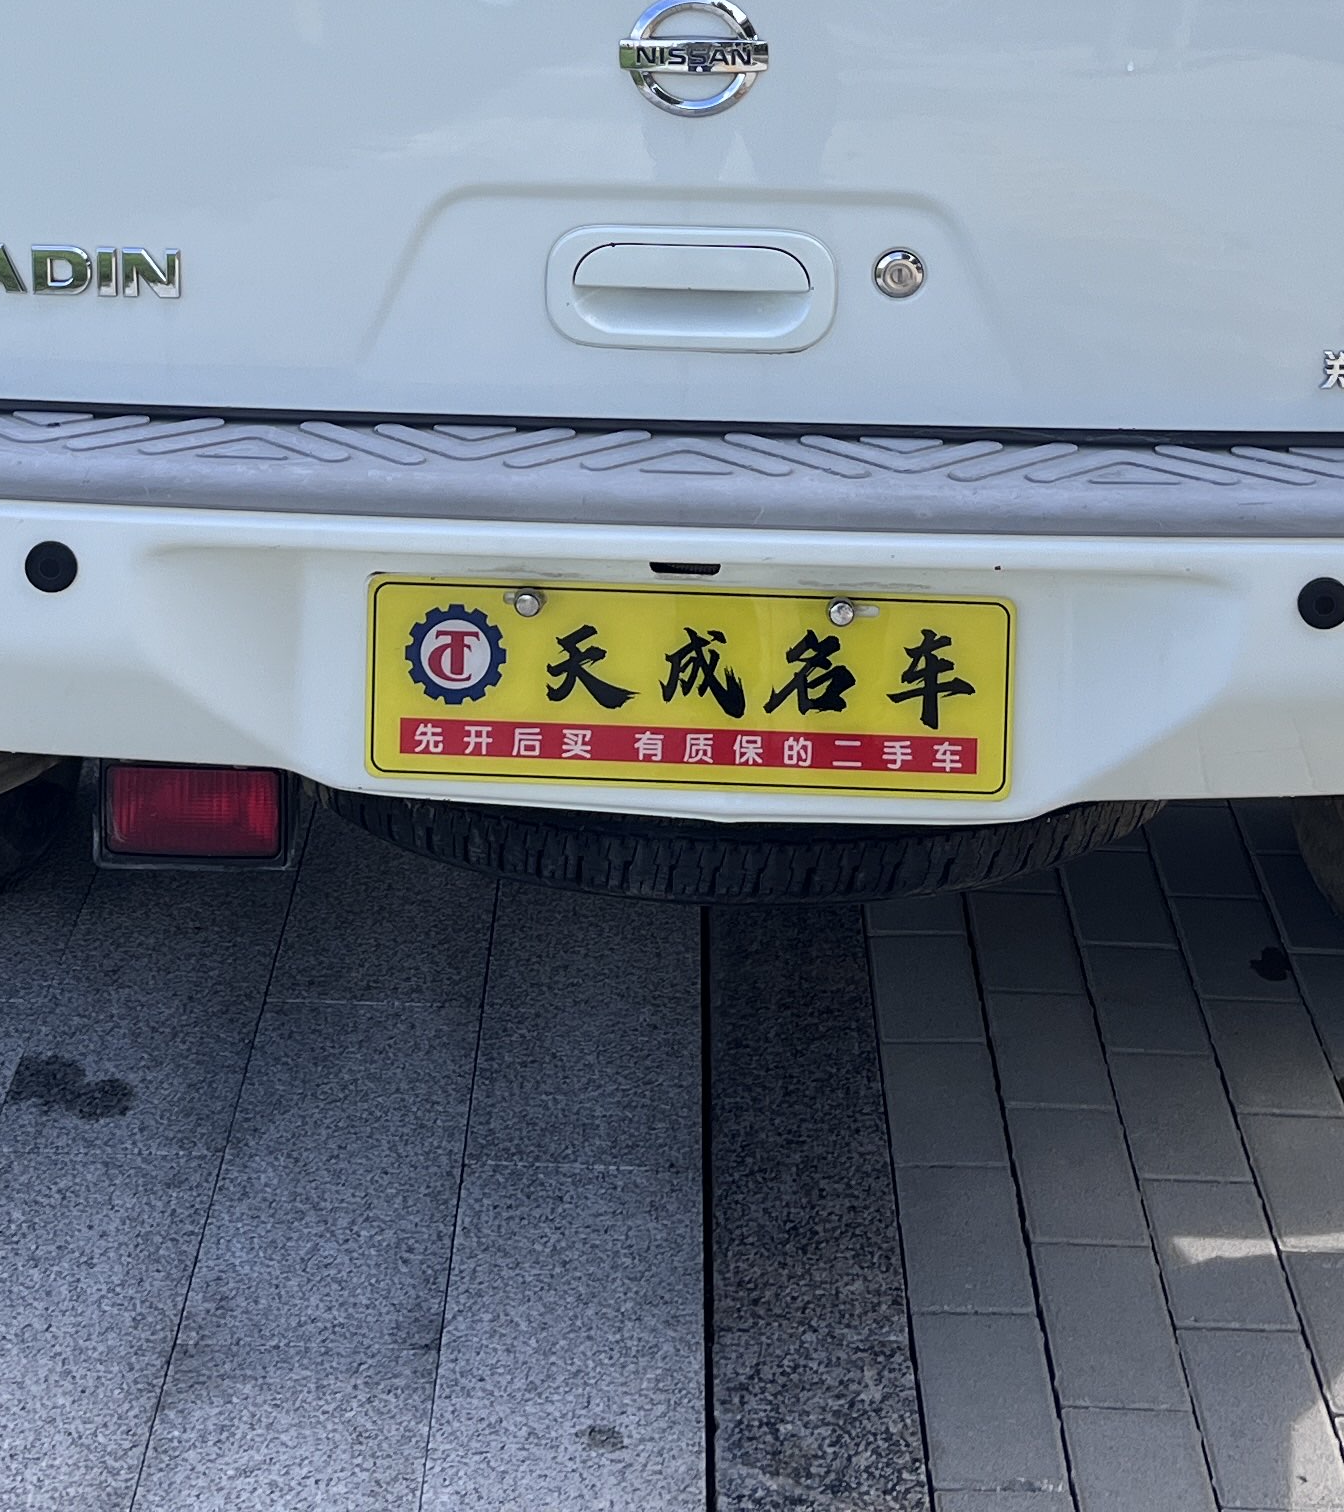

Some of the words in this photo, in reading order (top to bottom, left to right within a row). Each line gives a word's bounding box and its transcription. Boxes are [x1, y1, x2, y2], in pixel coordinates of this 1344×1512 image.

[636, 46, 753, 66] NISSAN
[546, 624, 977, 730] 天成名车
[413, 723, 592, 758] 先开后买
[635, 730, 963, 772] 有质保的二手车
